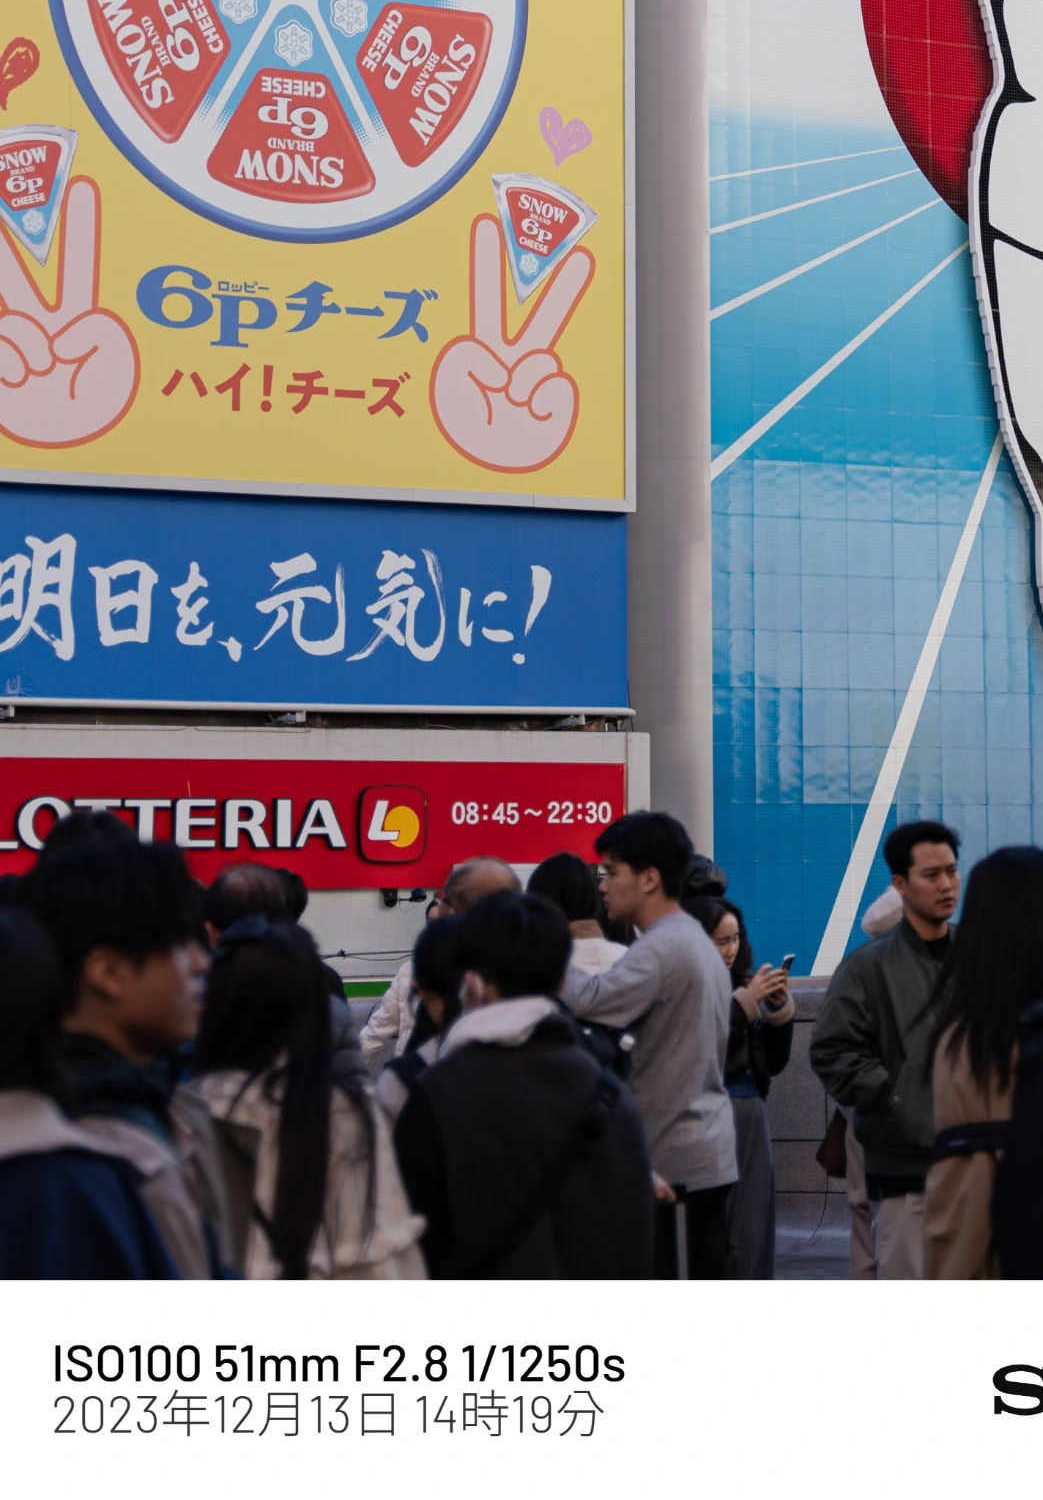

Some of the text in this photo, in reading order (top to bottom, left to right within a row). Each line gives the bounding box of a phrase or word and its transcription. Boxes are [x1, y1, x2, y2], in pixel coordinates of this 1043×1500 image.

[141, 16, 172, 68] BRAND
[361, 9, 403, 73] CHEESE
[261, 76, 326, 98] CHEESE
[408, 33, 476, 146] SNOW
[411, 51, 441, 97] BRAND
[267, 137, 315, 152] BRAND
[234, 148, 345, 188] SNOW
[11, 192, 46, 207] CHEESE
[518, 193, 569, 224] SNOW
[519, 236, 549, 254] CHEESE
[218, 280, 270, 294] ロッピー
[161, 362, 411, 418] ハイ!チーズ
